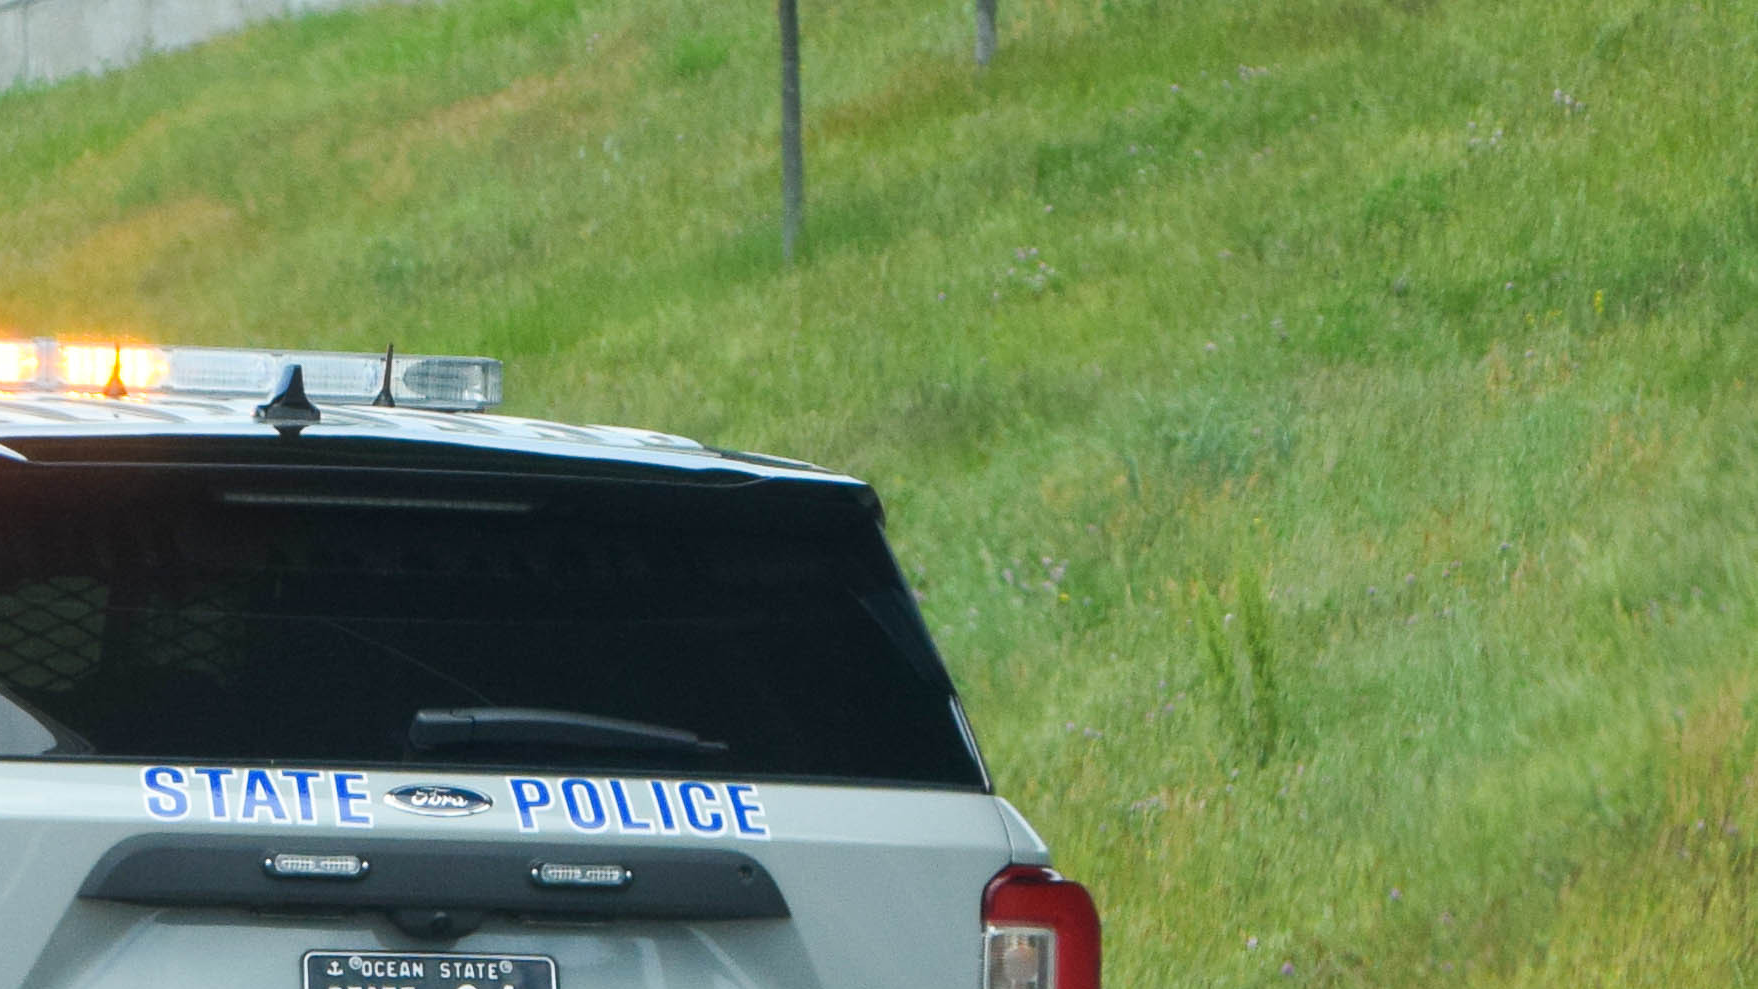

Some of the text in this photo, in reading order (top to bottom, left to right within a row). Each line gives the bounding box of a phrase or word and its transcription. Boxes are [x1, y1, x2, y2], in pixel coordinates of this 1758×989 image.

[142, 766, 769, 840] STATE POLICE
[410, 786, 468, 807] Ford
[362, 961, 499, 980] OCEAN STATE
